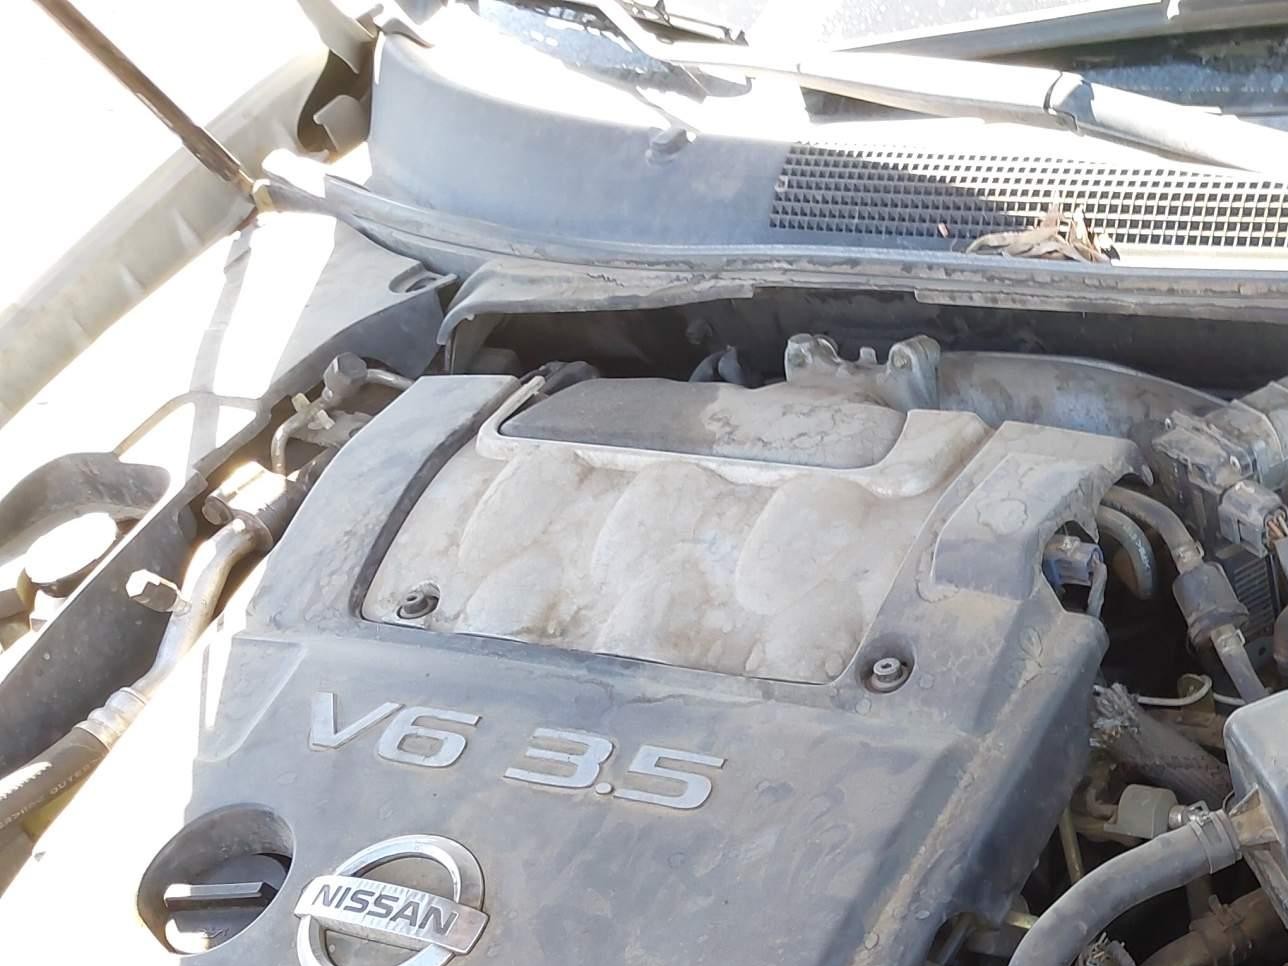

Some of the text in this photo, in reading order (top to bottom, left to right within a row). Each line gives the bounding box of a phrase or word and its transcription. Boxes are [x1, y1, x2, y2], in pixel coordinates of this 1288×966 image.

[309, 692, 725, 809] V6 3.5
[313, 881, 458, 936] NISSAN
